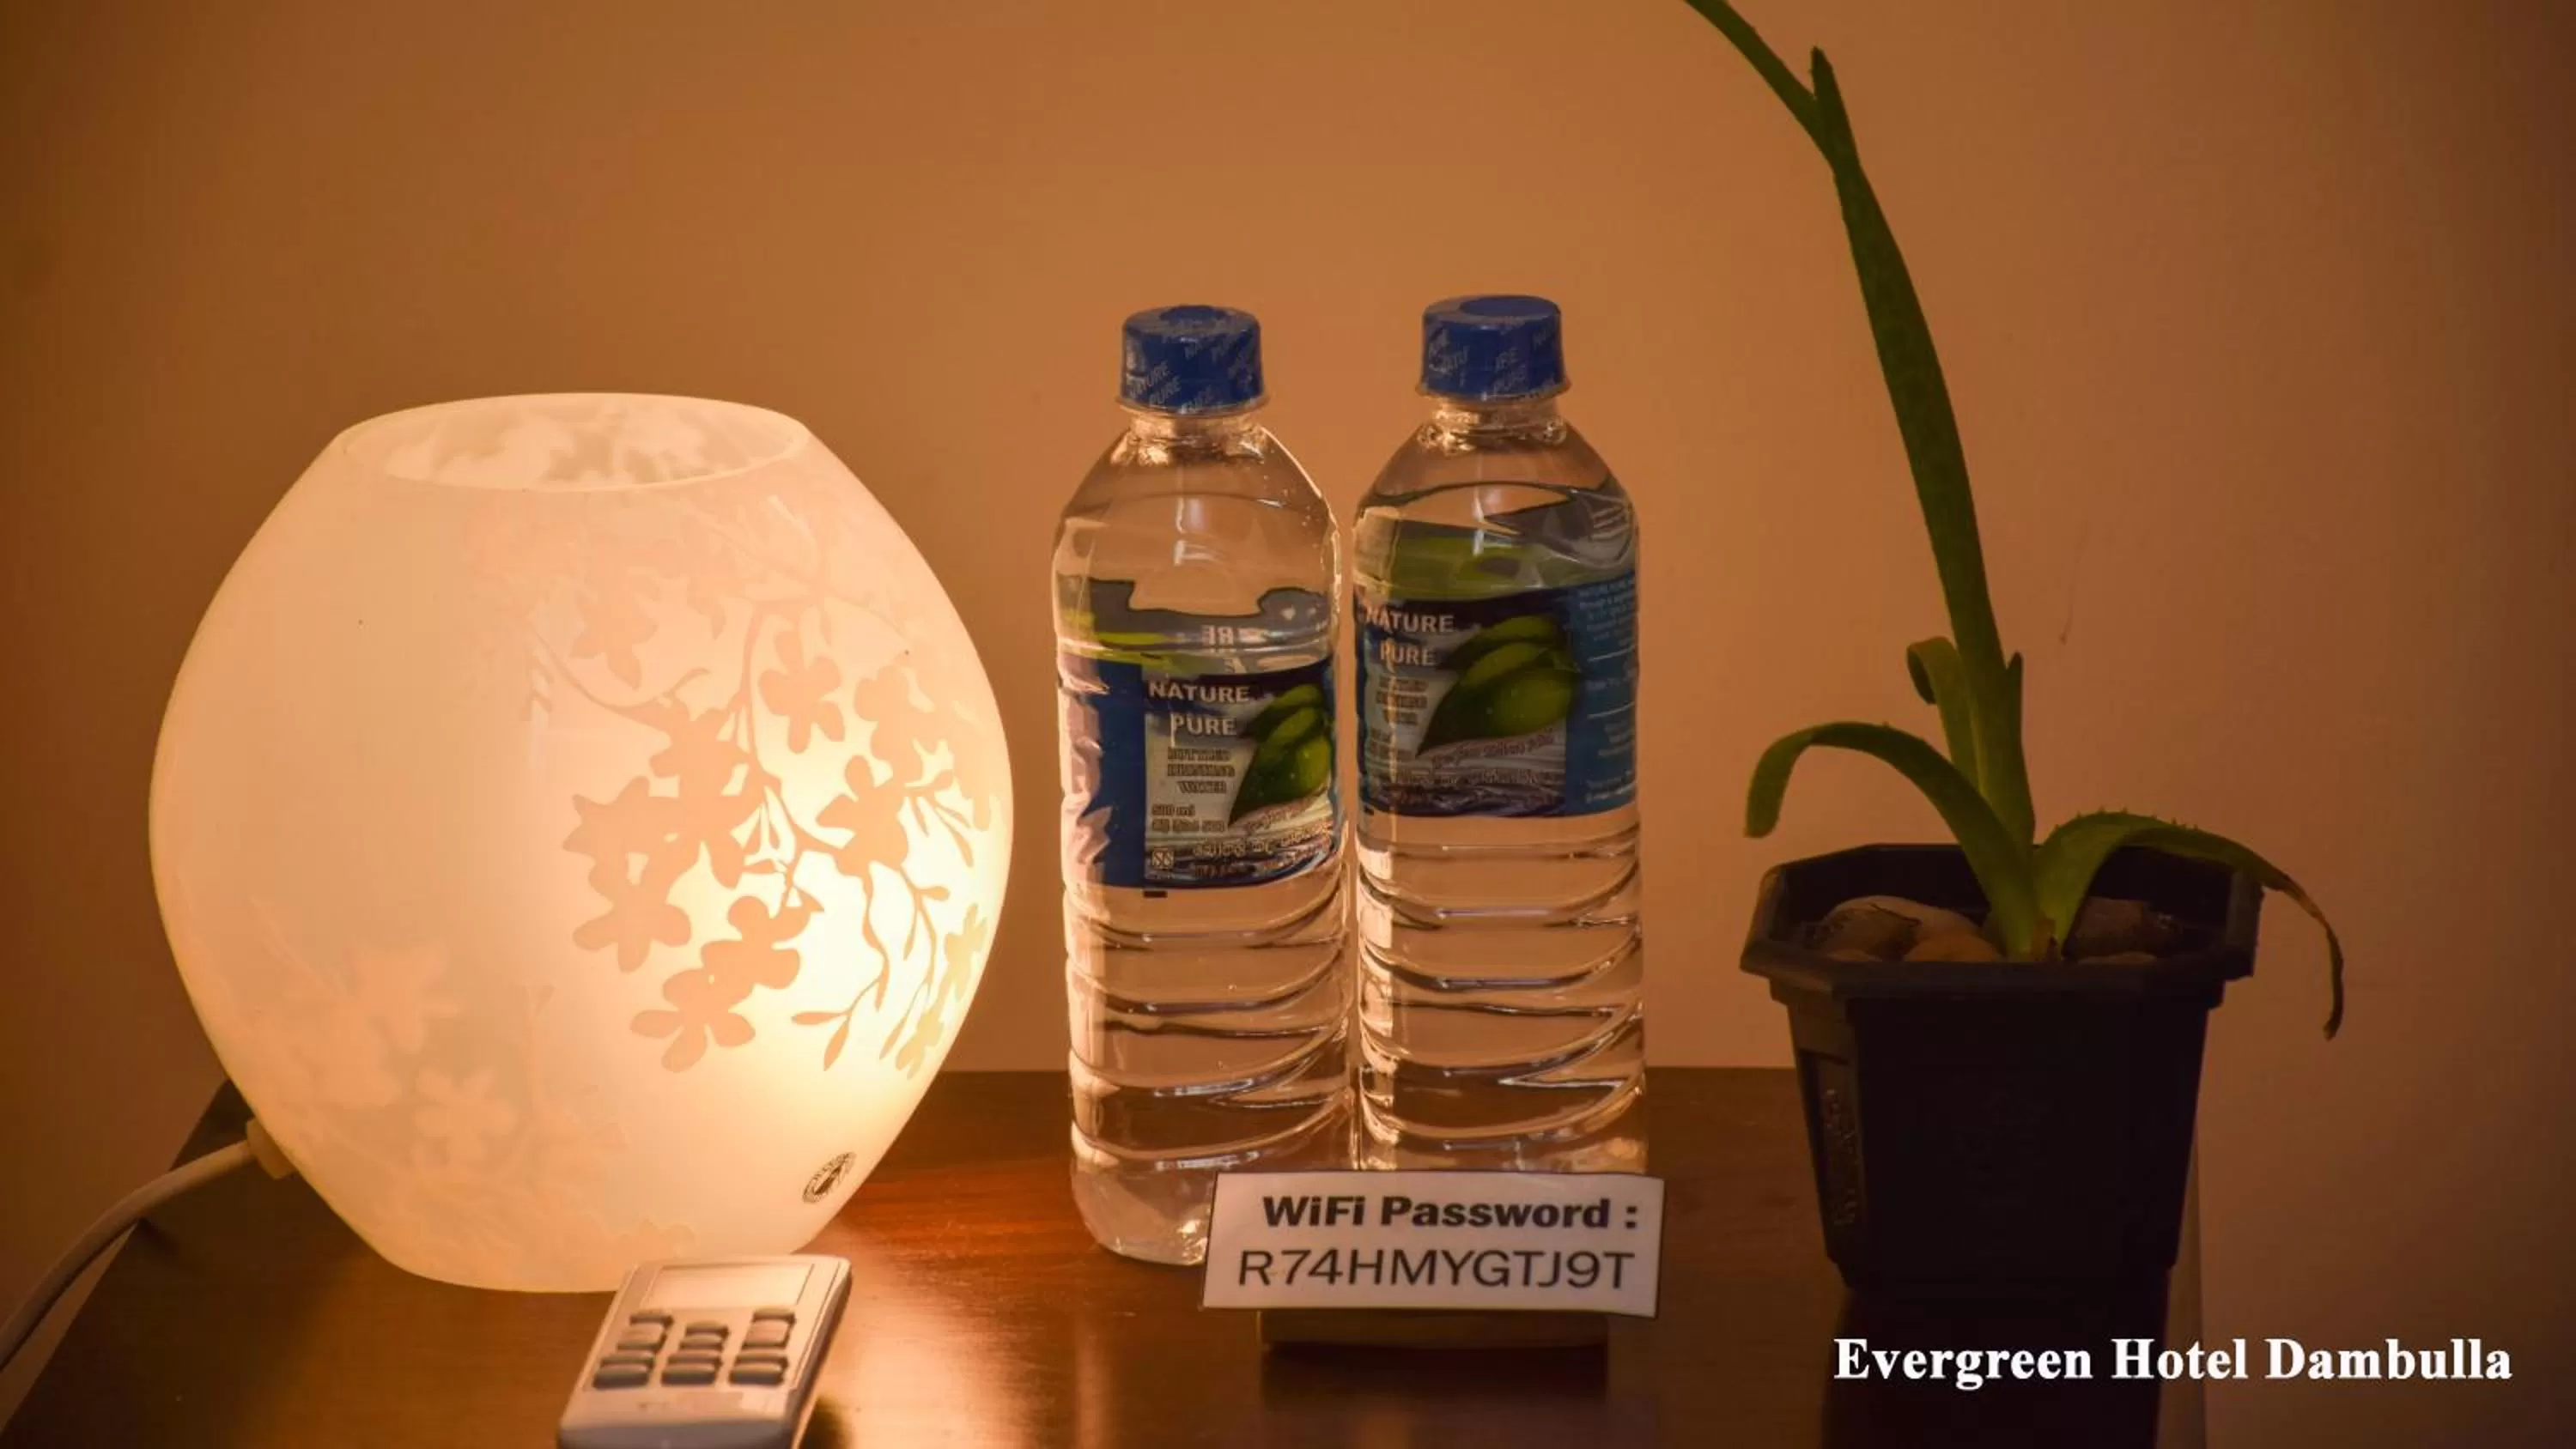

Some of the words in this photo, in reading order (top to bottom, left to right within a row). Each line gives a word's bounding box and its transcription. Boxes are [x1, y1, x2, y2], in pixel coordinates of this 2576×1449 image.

[1149, 682, 1250, 703] NATURE
[1171, 714, 1236, 737] PURE
[1262, 1196, 1366, 1228] WiFi
[1380, 1196, 1612, 1229] Password
[1238, 1248, 1636, 1289] R74HMYGTJ9T
